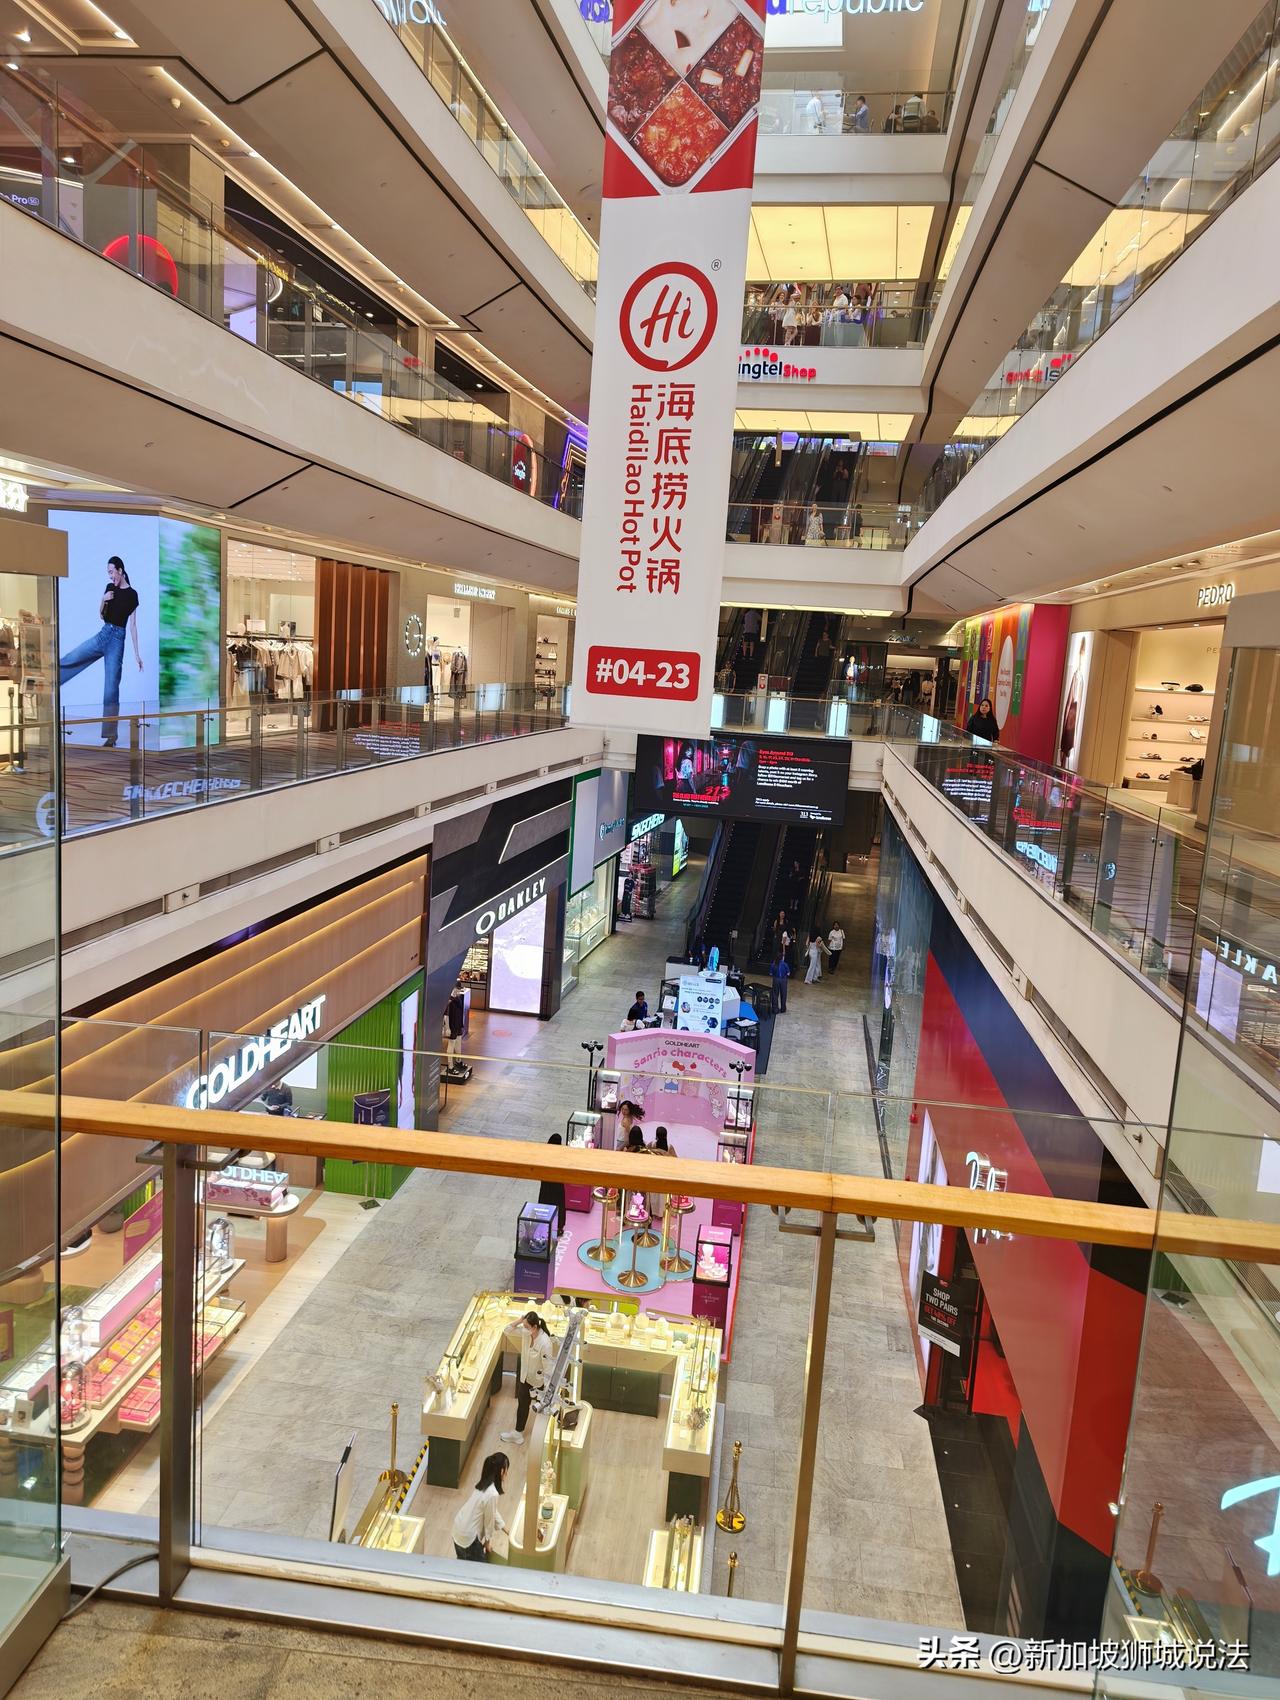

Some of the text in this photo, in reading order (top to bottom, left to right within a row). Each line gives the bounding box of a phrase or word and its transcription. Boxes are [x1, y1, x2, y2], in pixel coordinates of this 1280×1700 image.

[640, 284, 695, 348] Hi
[616, 383, 653, 594] Haidilao Hot Pot
[646, 382, 696, 595] 海底捞火锅
[1197, 583, 1236, 607] PEDRO
[595, 657, 691, 690] #04-23
[498, 876, 546, 921] OAKLEY
[185, 994, 327, 1111] GOLDHEART
[664, 1040, 700, 1049] GOLDHEART
[633, 1047, 728, 1078] Sanrio characters
[925, 1292, 959, 1317] TWO PAIRS
[932, 1287, 951, 1302] SHOP
